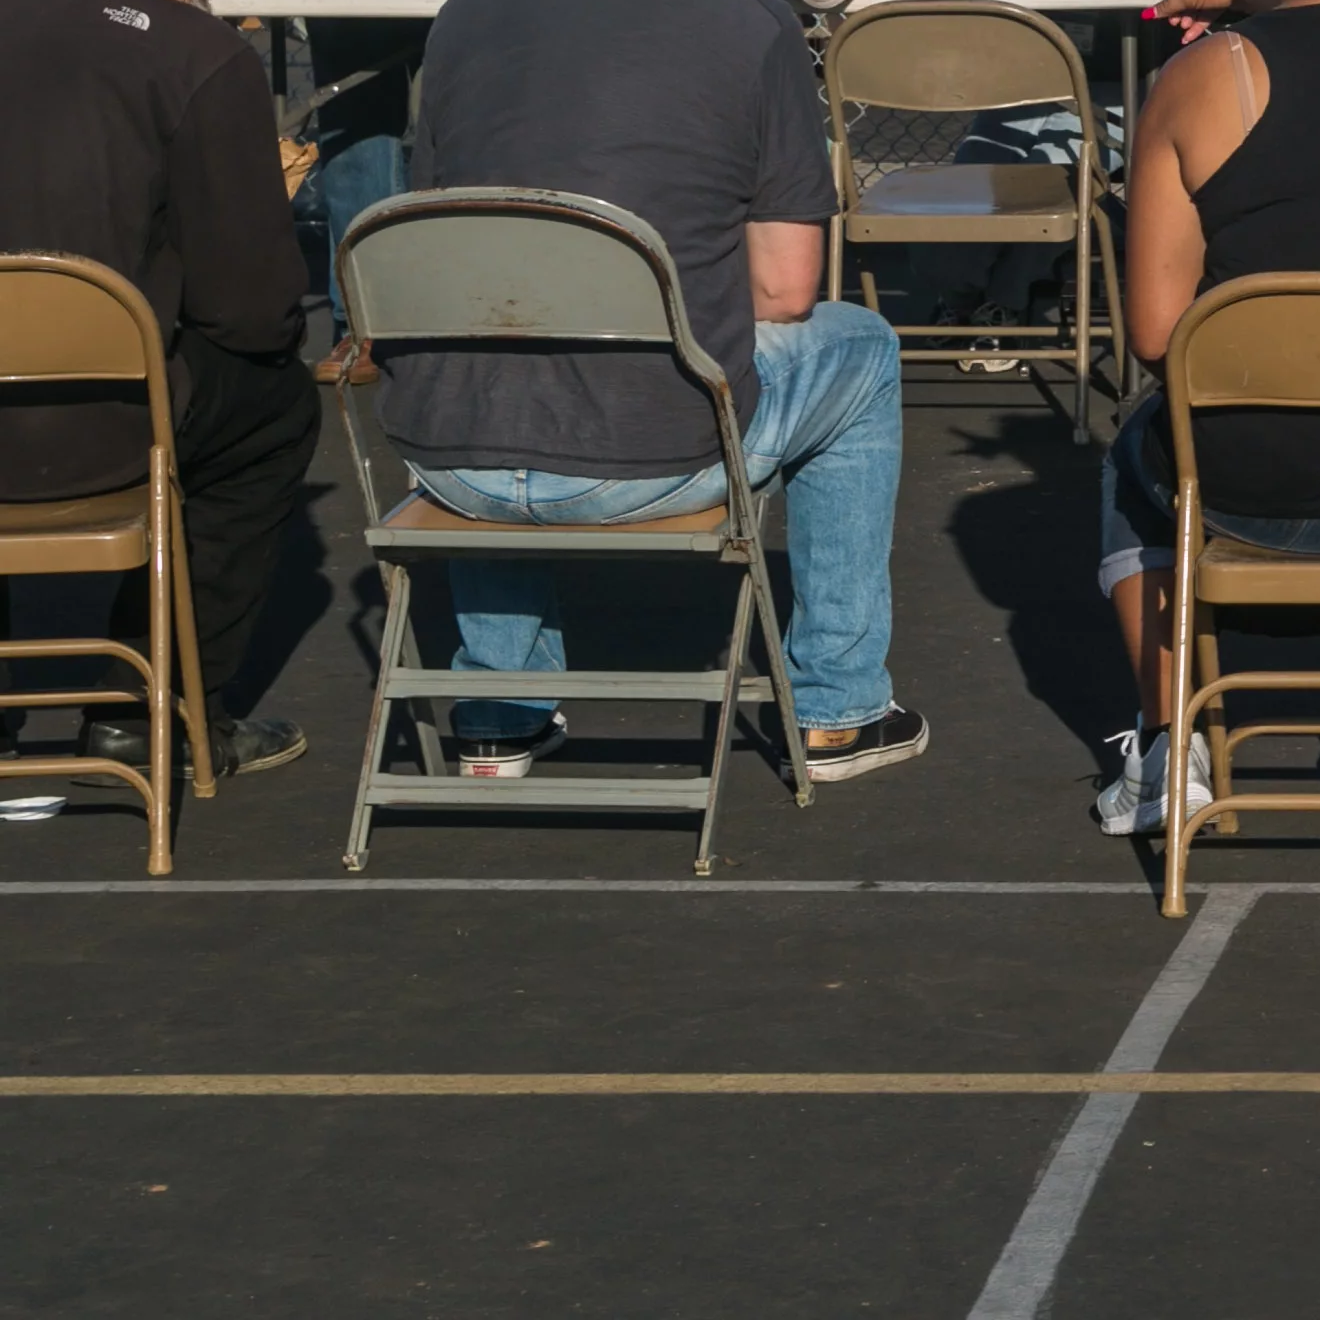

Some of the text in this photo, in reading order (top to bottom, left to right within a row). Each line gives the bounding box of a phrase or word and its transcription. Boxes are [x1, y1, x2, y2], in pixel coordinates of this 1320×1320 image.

[103, 7, 137, 21] NORTH
[121, 5, 140, 16] THE
[109, 15, 131, 26] FACE
